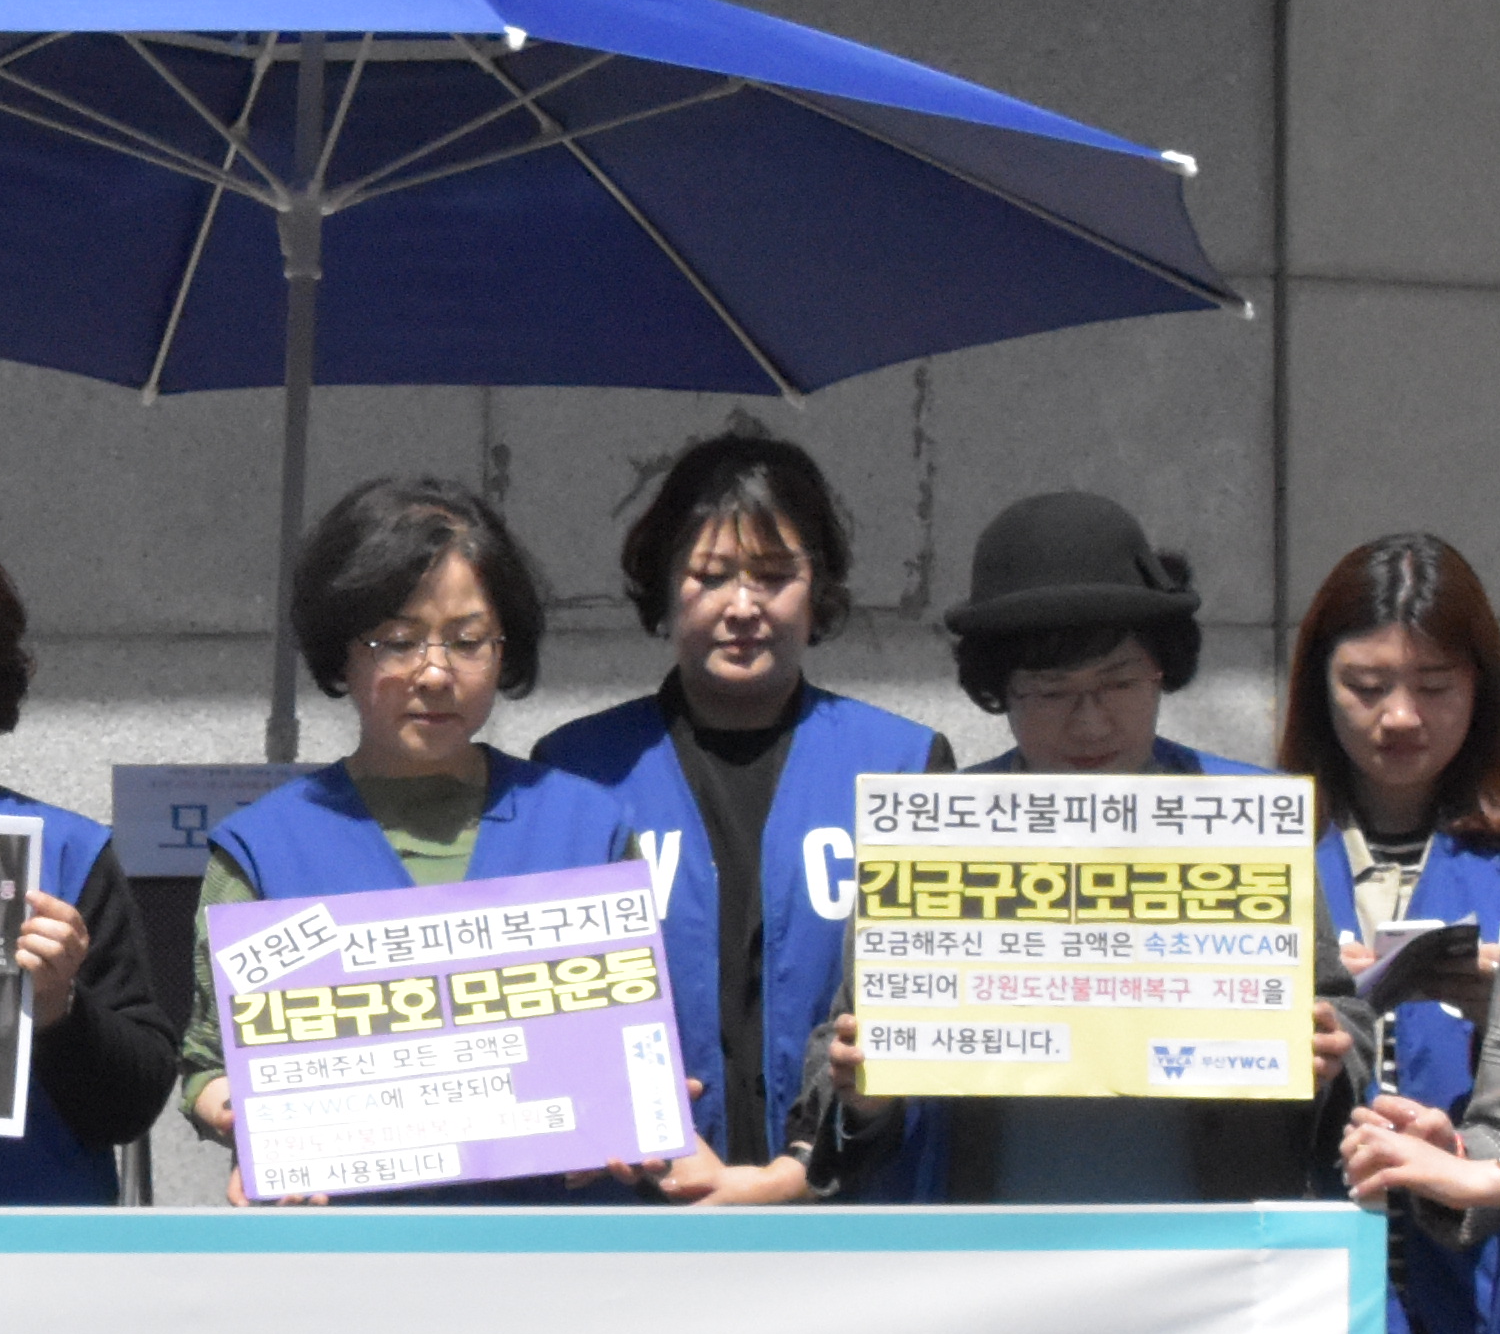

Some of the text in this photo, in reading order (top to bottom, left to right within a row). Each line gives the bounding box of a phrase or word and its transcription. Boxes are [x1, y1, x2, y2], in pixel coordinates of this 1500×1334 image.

[1151, 794, 1307, 836] 복구지원
[860, 862, 1289, 921] 긴급구호 모금운동
[229, 894, 651, 985] 강원도 산불피해 복구지원
[863, 931, 1299, 959] 모금해주신 모든 금액은 속초YWCA에
[233, 947, 658, 1046] 긴급구호 모금운동
[863, 972, 1286, 1005] 전달되어 강원도산불피해복구 지원을
[260, 1033, 524, 1086] 모금해주신 모든 금액은
[869, 1025, 1061, 1057] 위해 사용됩니다.
[419, 1072, 515, 1106] 전달되어
[264, 1166, 311, 1192] 위해
